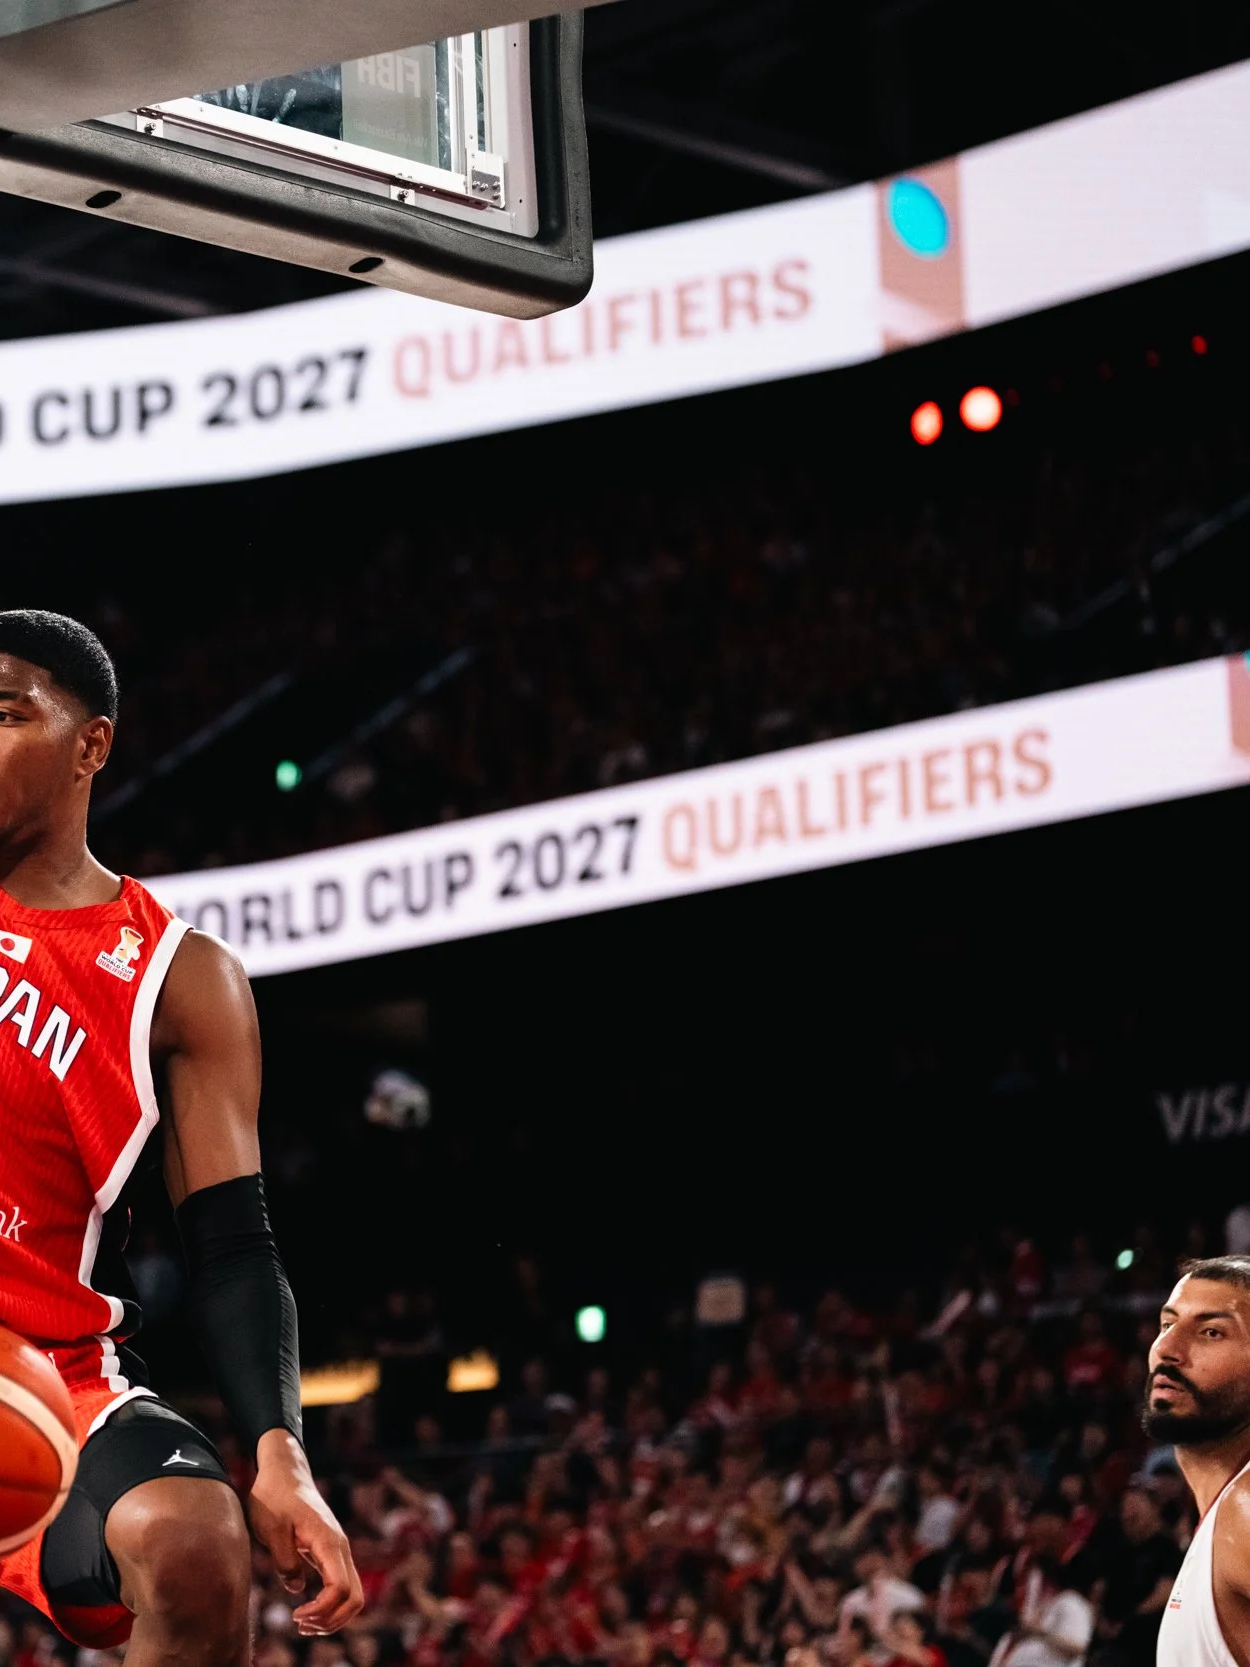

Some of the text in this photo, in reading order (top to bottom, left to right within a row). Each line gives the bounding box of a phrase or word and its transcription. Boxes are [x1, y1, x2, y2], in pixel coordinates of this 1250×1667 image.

[32, 379, 174, 446] CUP
[202, 346, 368, 428] 2027
[392, 260, 813, 399] QUALIFIERS
[178, 878, 345, 946] ORLD
[364, 852, 474, 925] CUP
[494, 815, 640, 899] 2027
[661, 728, 1054, 873] QUALIFIERS
